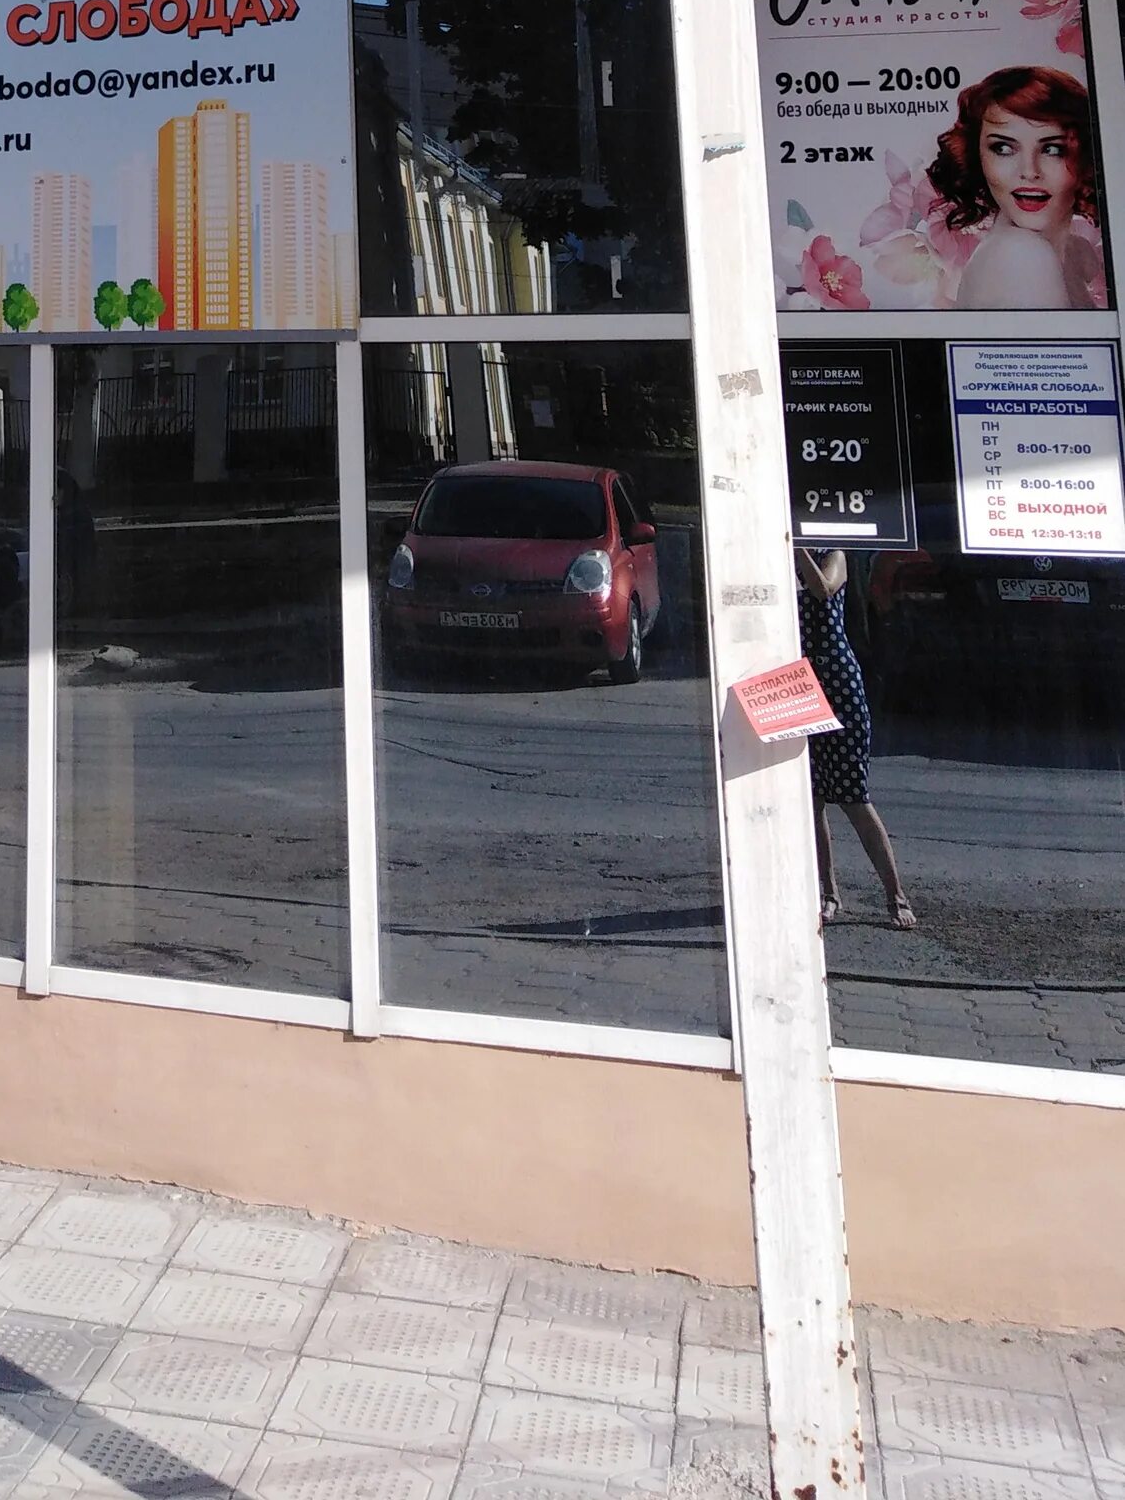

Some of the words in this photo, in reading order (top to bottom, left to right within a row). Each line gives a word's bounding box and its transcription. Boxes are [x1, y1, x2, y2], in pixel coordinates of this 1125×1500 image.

[808, 14, 882, 27] студия
[897, 10, 989, 23] красоты
[776, 71, 839, 95] 9:00
[878, 66, 961, 92] 20:00
[777, 101, 802, 118] без
[806, 100, 850, 119] обеда
[855, 103, 863, 115] и
[867, 100, 949, 117] выходных
[780, 141, 796, 164] 2
[805, 146, 874, 163] этаж
[978, 352, 1038, 360] Управляющая
[1041, 352, 1082, 360] компания
[975, 363, 1017, 371] Общество
[1027, 363, 1088, 371] ограниченной
[791, 369, 820, 378] BODY
[824, 369, 861, 378] DREAM
[962, 381, 1038, 391] «ОРУЖЕЙНАЯ
[1041, 383, 1104, 392] СЛОБОДА»
[786, 403, 826, 412] ГРАФИК
[829, 403, 872, 412] РАБОТЫ
[986, 403, 1026, 413] ЧАСЫ
[1030, 403, 1087, 413] РАБОТЫ
[981, 421, 1000, 431] ПН
[982, 436, 998, 446] ВТ
[1017, 444, 1091, 454] 8:00-17:00
[984, 451, 1001, 461] СР
[985, 466, 1002, 476] ЧТ
[986, 480, 1003, 490] ПТ
[1020, 479, 1095, 490] 8:00-16:00
[987, 496, 1006, 506] СБ
[1017, 503, 1107, 516] ВЫХОДНОЙ
[988, 510, 1006, 520] ВС
[989, 528, 1024, 539] ОБЕД
[741, 667, 809, 697] БЕСПЛАТНАЯ
[747, 681, 814, 708] ПОМОЩЬ
